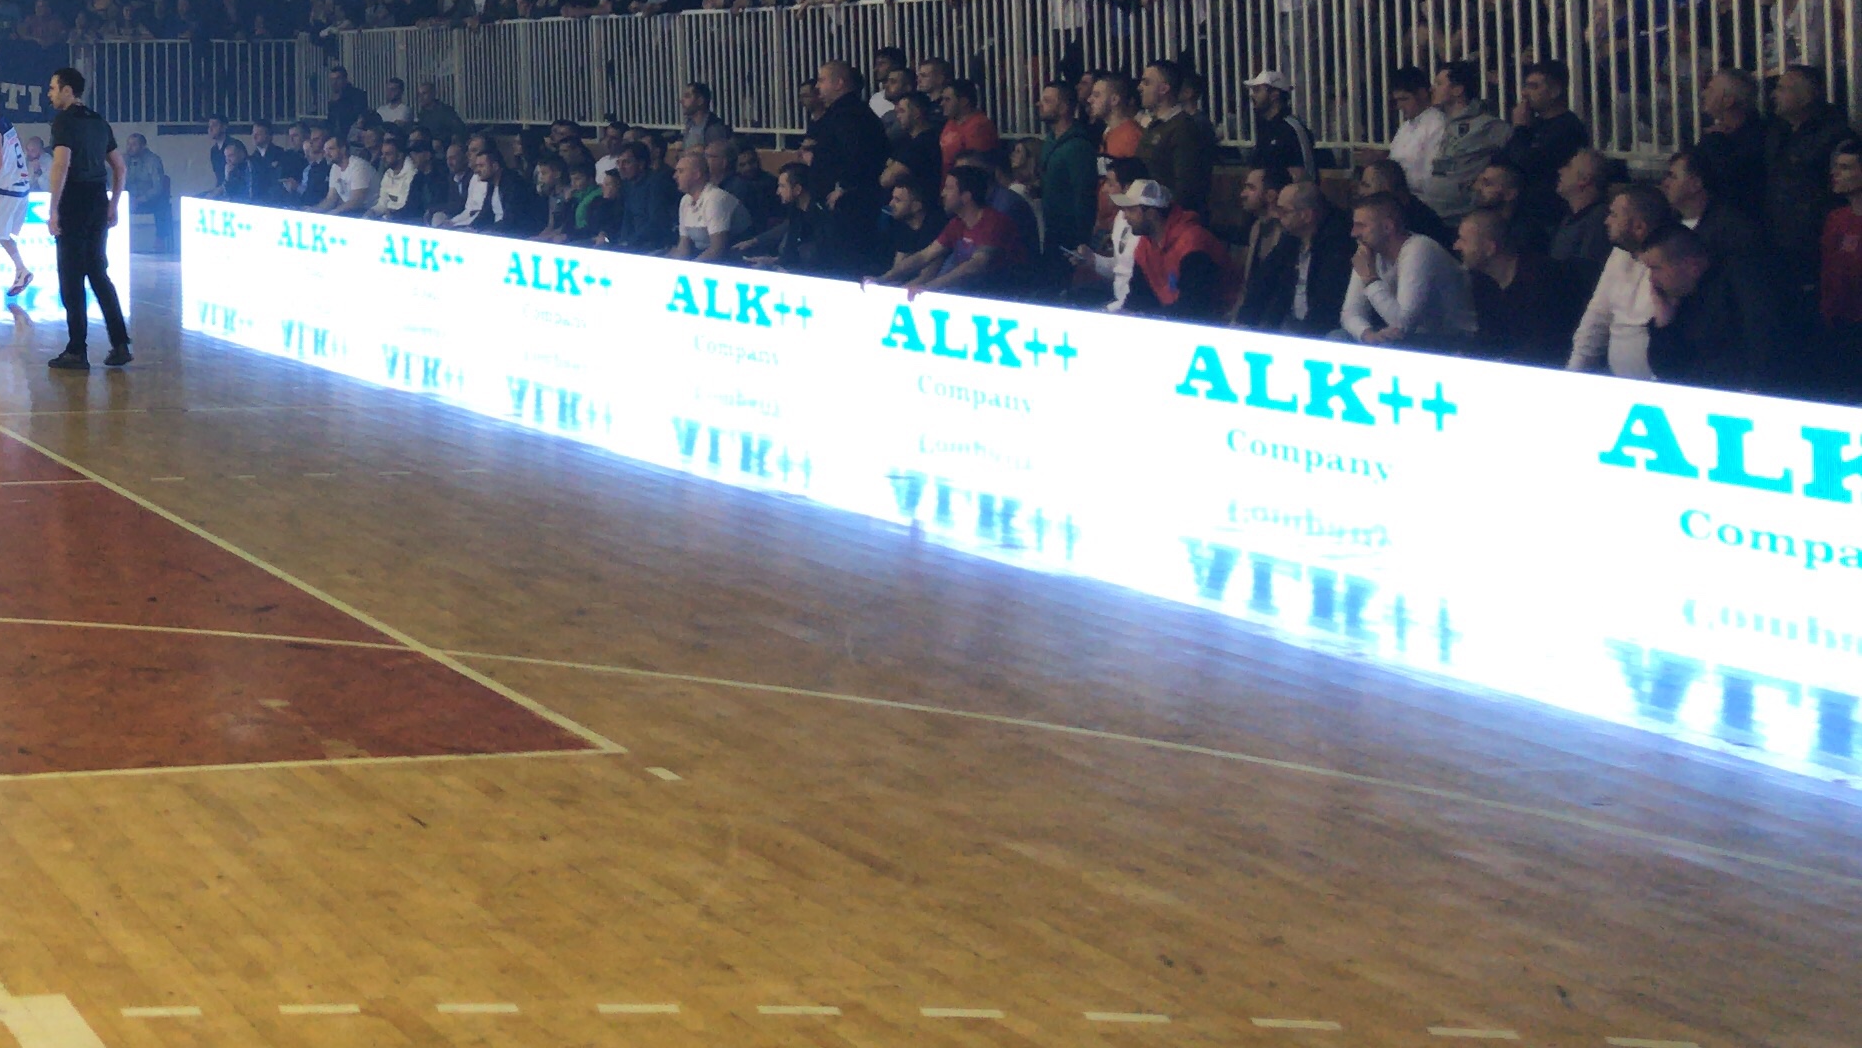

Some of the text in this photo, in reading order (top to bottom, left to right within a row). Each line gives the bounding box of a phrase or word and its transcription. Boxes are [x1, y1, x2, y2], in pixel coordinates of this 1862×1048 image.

[278, 218, 349, 255] ALK++
[380, 233, 466, 274] ALK++
[503, 251, 614, 298] ALK++
[666, 274, 815, 330] ALK++
[694, 335, 781, 368] Company
[880, 303, 1080, 373] ALK++
[917, 374, 1034, 416] Company
[1174, 344, 1460, 433] ALK++
[1226, 428, 1396, 484] Company
